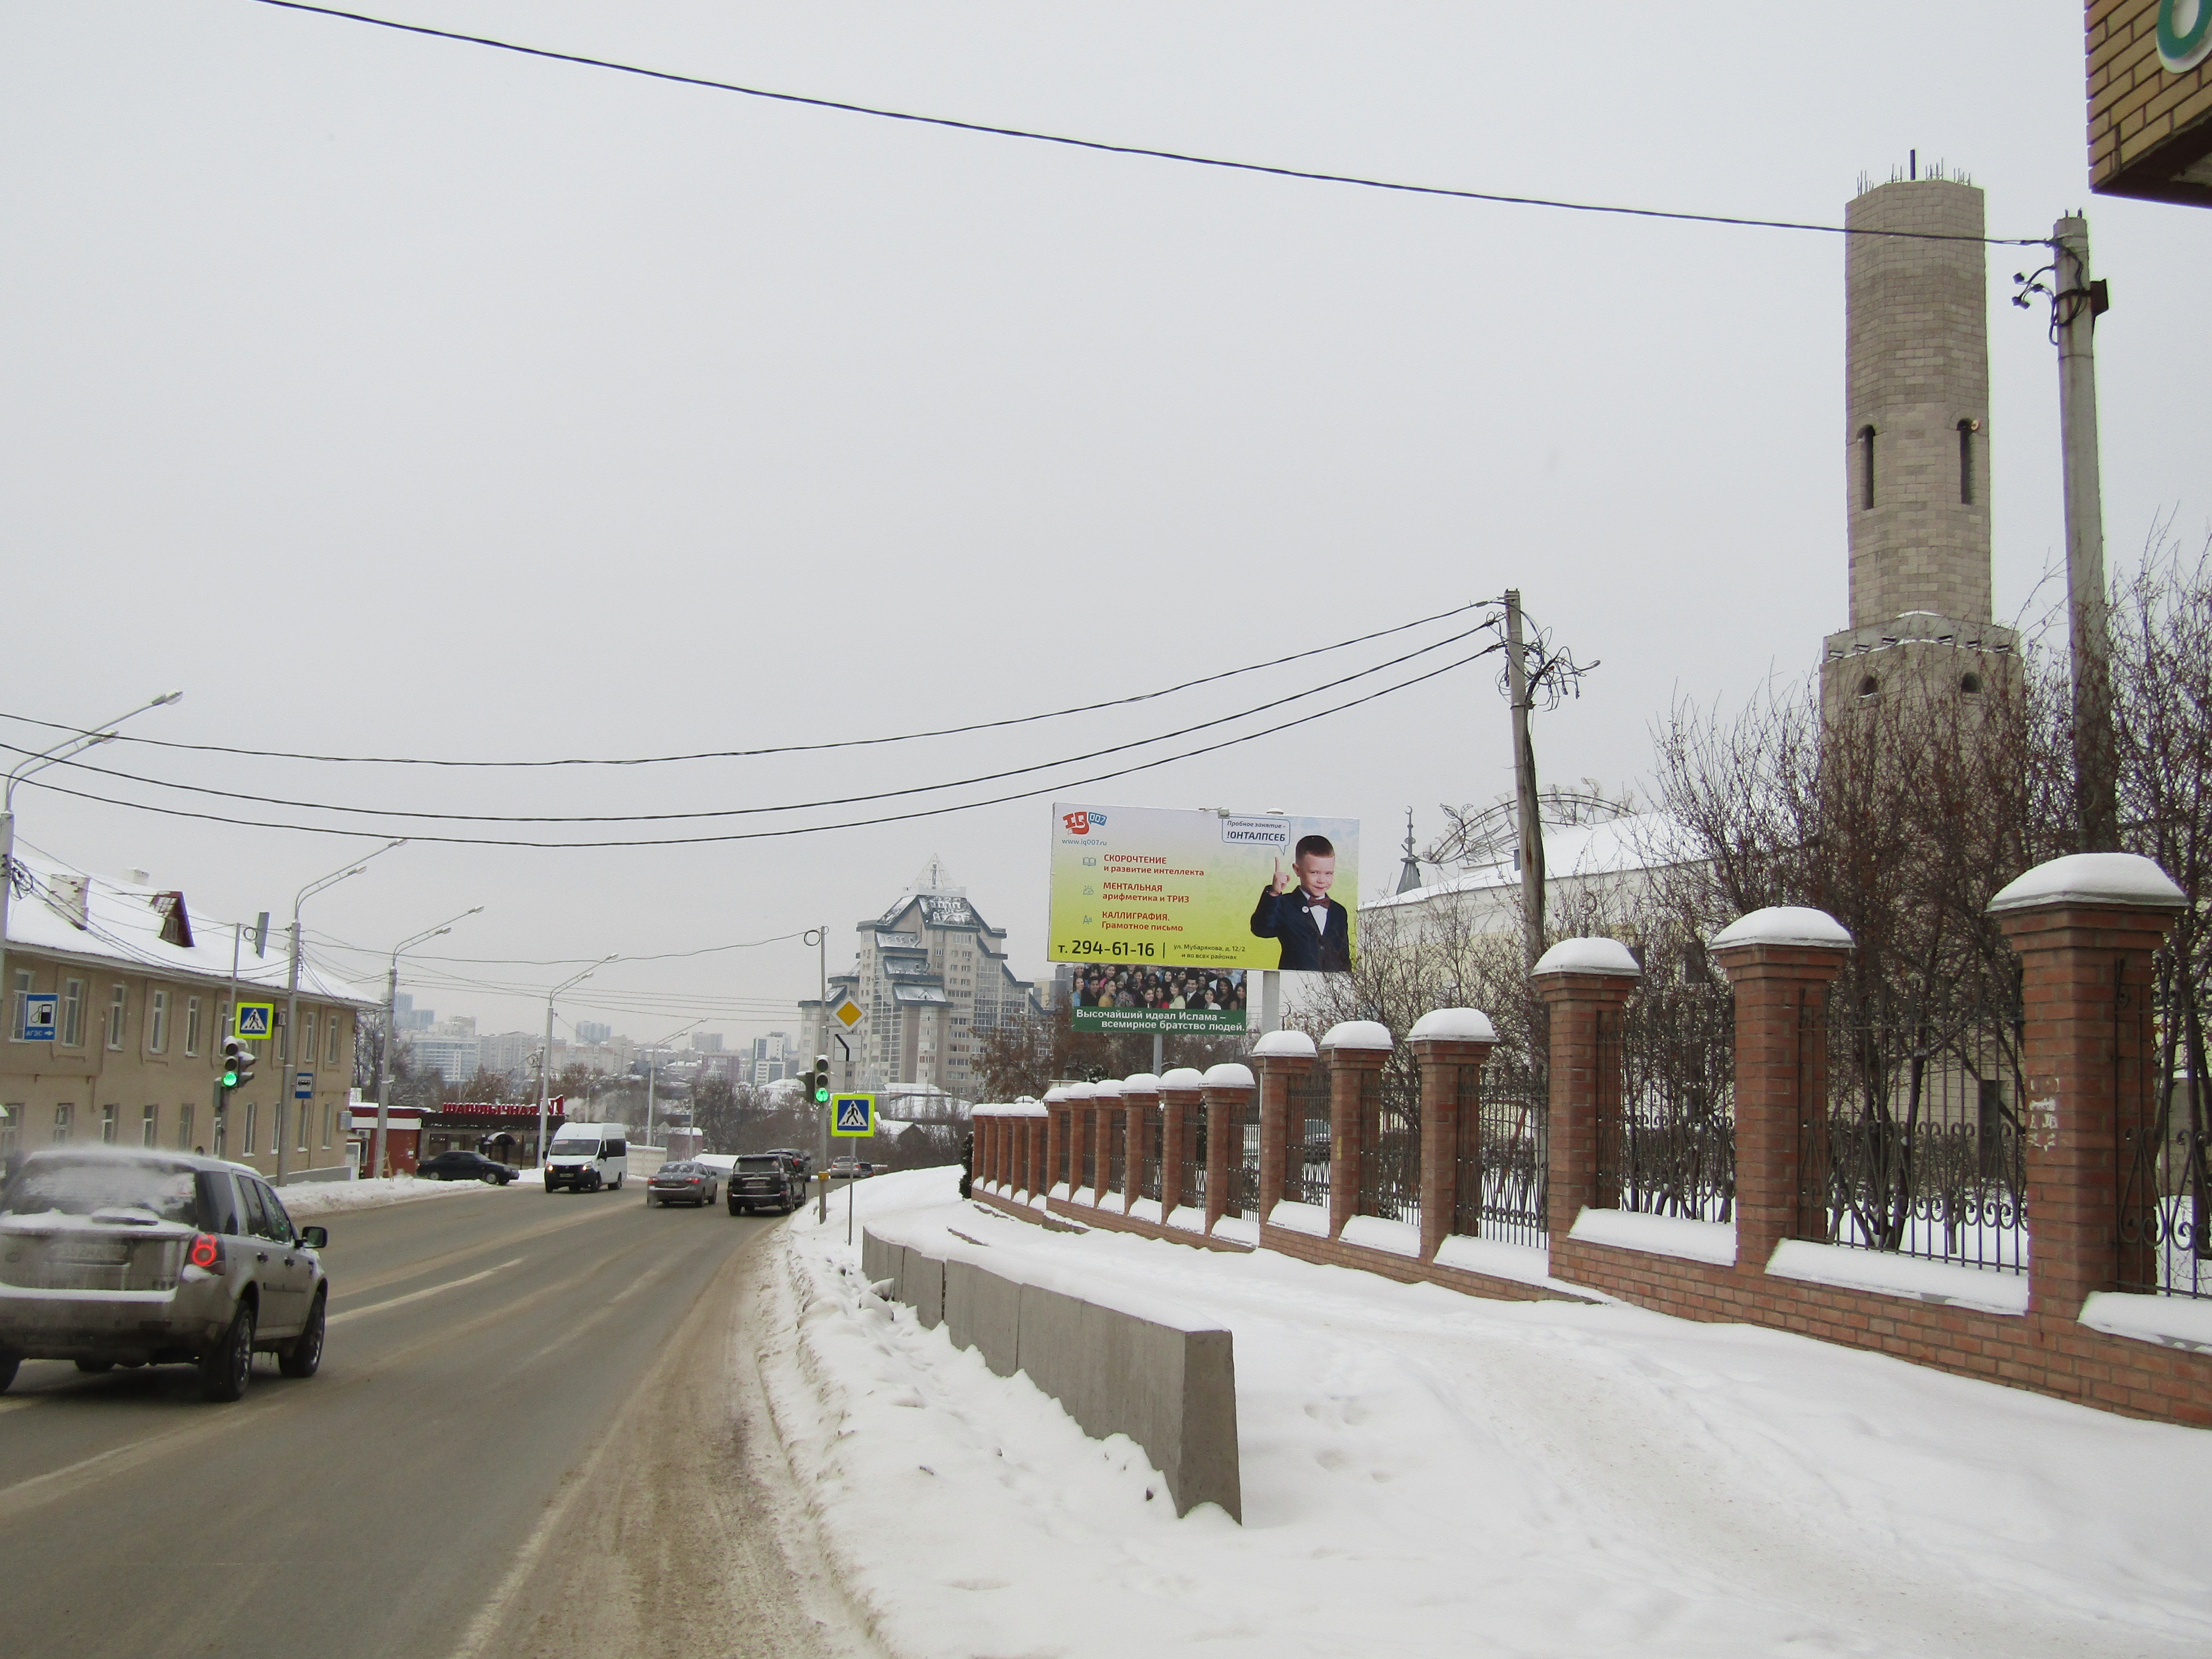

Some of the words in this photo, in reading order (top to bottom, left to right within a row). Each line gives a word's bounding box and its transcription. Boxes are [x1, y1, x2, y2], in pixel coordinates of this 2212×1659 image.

[1090, 814, 1106, 823] 007
[1227, 831, 1285, 842] !ОНТАЛПСЕБ
[1104, 854, 1167, 864] СКОРОЧТЕНИЕ
[1154, 868, 1204, 876] интеллекта
[1103, 882, 1163, 892] МЕНТАЛЬНАЯ
[1103, 893, 1158, 902] арифметика
[1167, 895, 1189, 903] ТРИЗ
[1102, 911, 1170, 921] КАЛЛИГРАФИЯ.
[1102, 921, 1149, 930] Грамотное
[1058, 945, 1068, 953] т.
[1072, 940, 1155, 957] 294-61-16
[1076, 1009, 1143, 1019] Высочайший
[1146, 1012, 1176, 1021] идеал
[1179, 1012, 1218, 1021] Ислама
[1101, 1021, 1156, 1030] всемирное
[1160, 1021, 1206, 1030] братство
[1209, 1023, 1245, 1032] людей.
[443, 1102, 537, 1115] ШАШЛЫЧНАЯ
